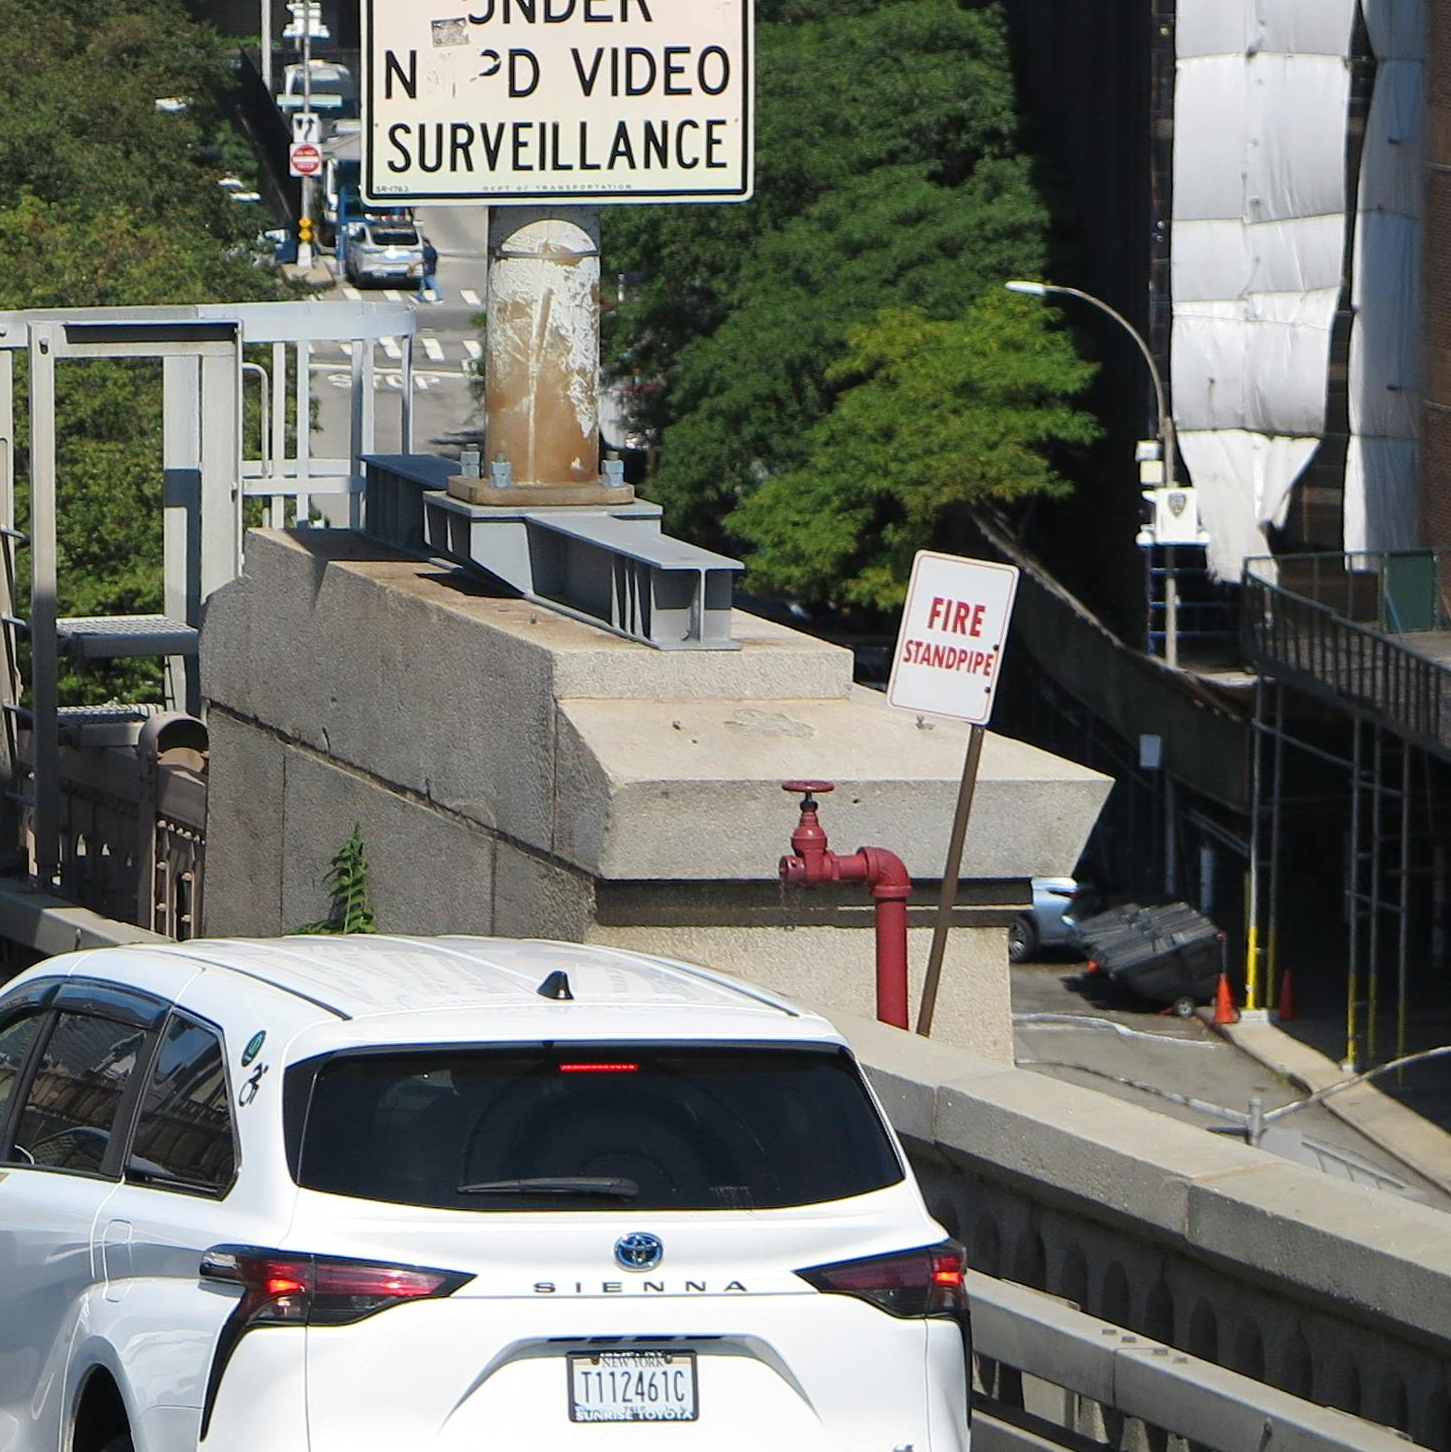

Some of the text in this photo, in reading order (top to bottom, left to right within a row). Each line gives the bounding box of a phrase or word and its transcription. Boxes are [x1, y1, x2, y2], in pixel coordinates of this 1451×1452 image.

[385, 45, 730, 100] ND VIDEO
[387, 119, 727, 173] SURVEILLANCE
[927, 596, 987, 638] FIRE
[903, 639, 995, 677] STANDPIPE
[532, 1280, 748, 1294] SIENNA
[602, 1356, 665, 1369] NEW YORK
[580, 1369, 686, 1404] T112461C
[575, 1410, 693, 1422] SUNRISE TOYOTA
